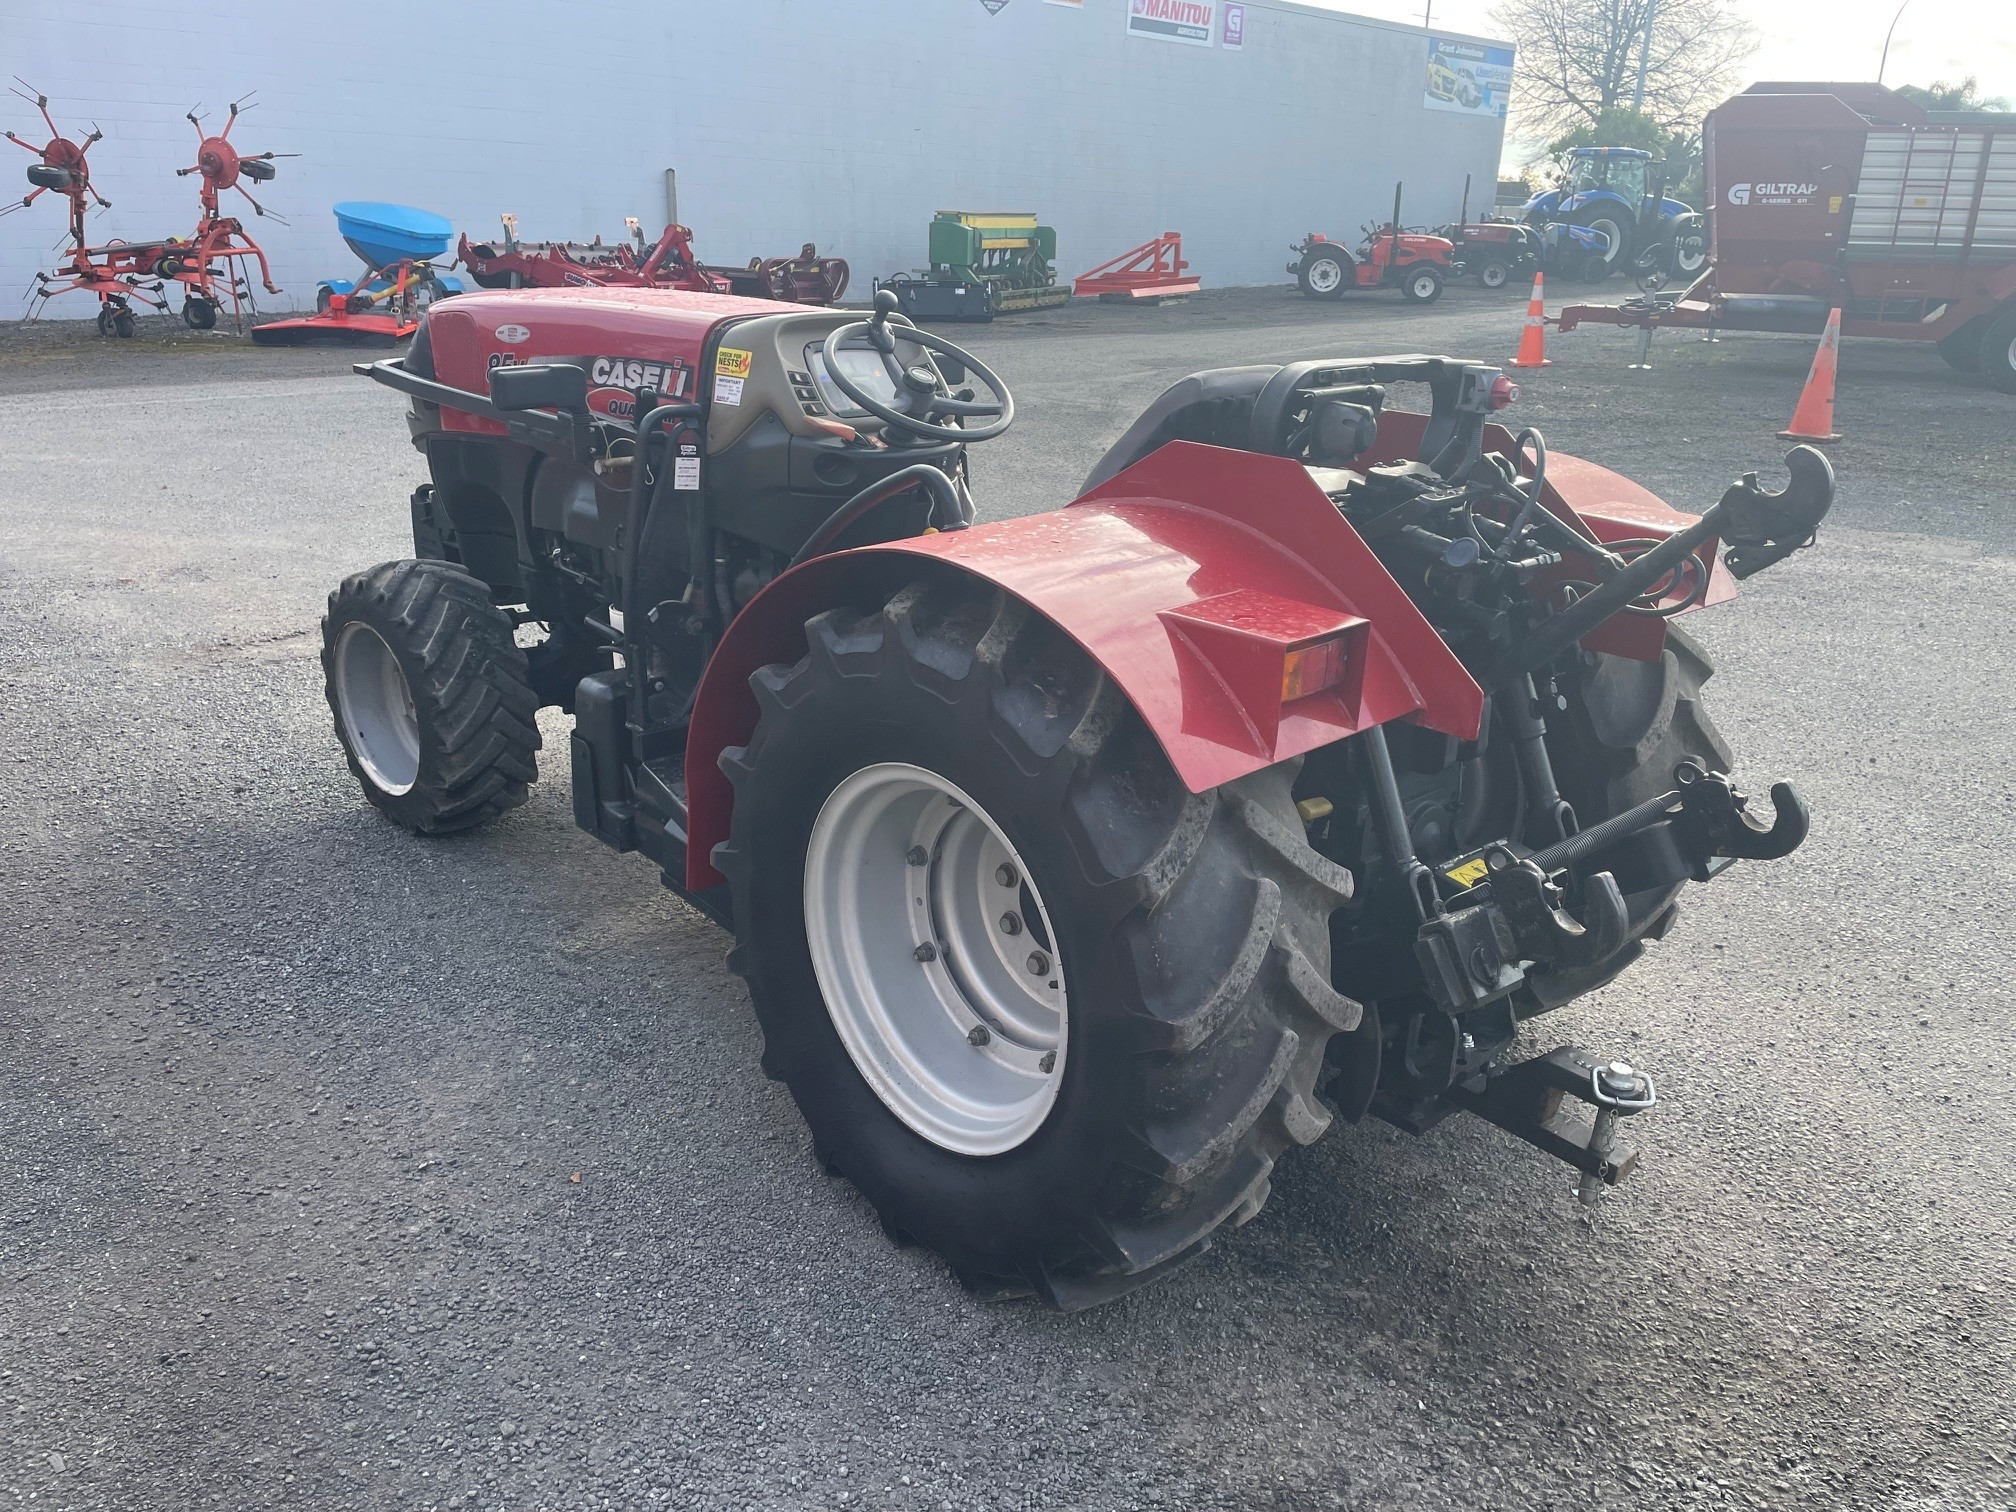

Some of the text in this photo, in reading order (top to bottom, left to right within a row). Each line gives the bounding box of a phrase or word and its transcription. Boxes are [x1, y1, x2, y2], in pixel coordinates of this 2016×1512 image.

[1145, 0, 1212, 26] MANITOU
[1438, 42, 1455, 54] Grant
[1755, 183, 1818, 195] GILTRAP
[719, 351, 733, 359] CHECK
[718, 357, 742, 369] NESTS!
